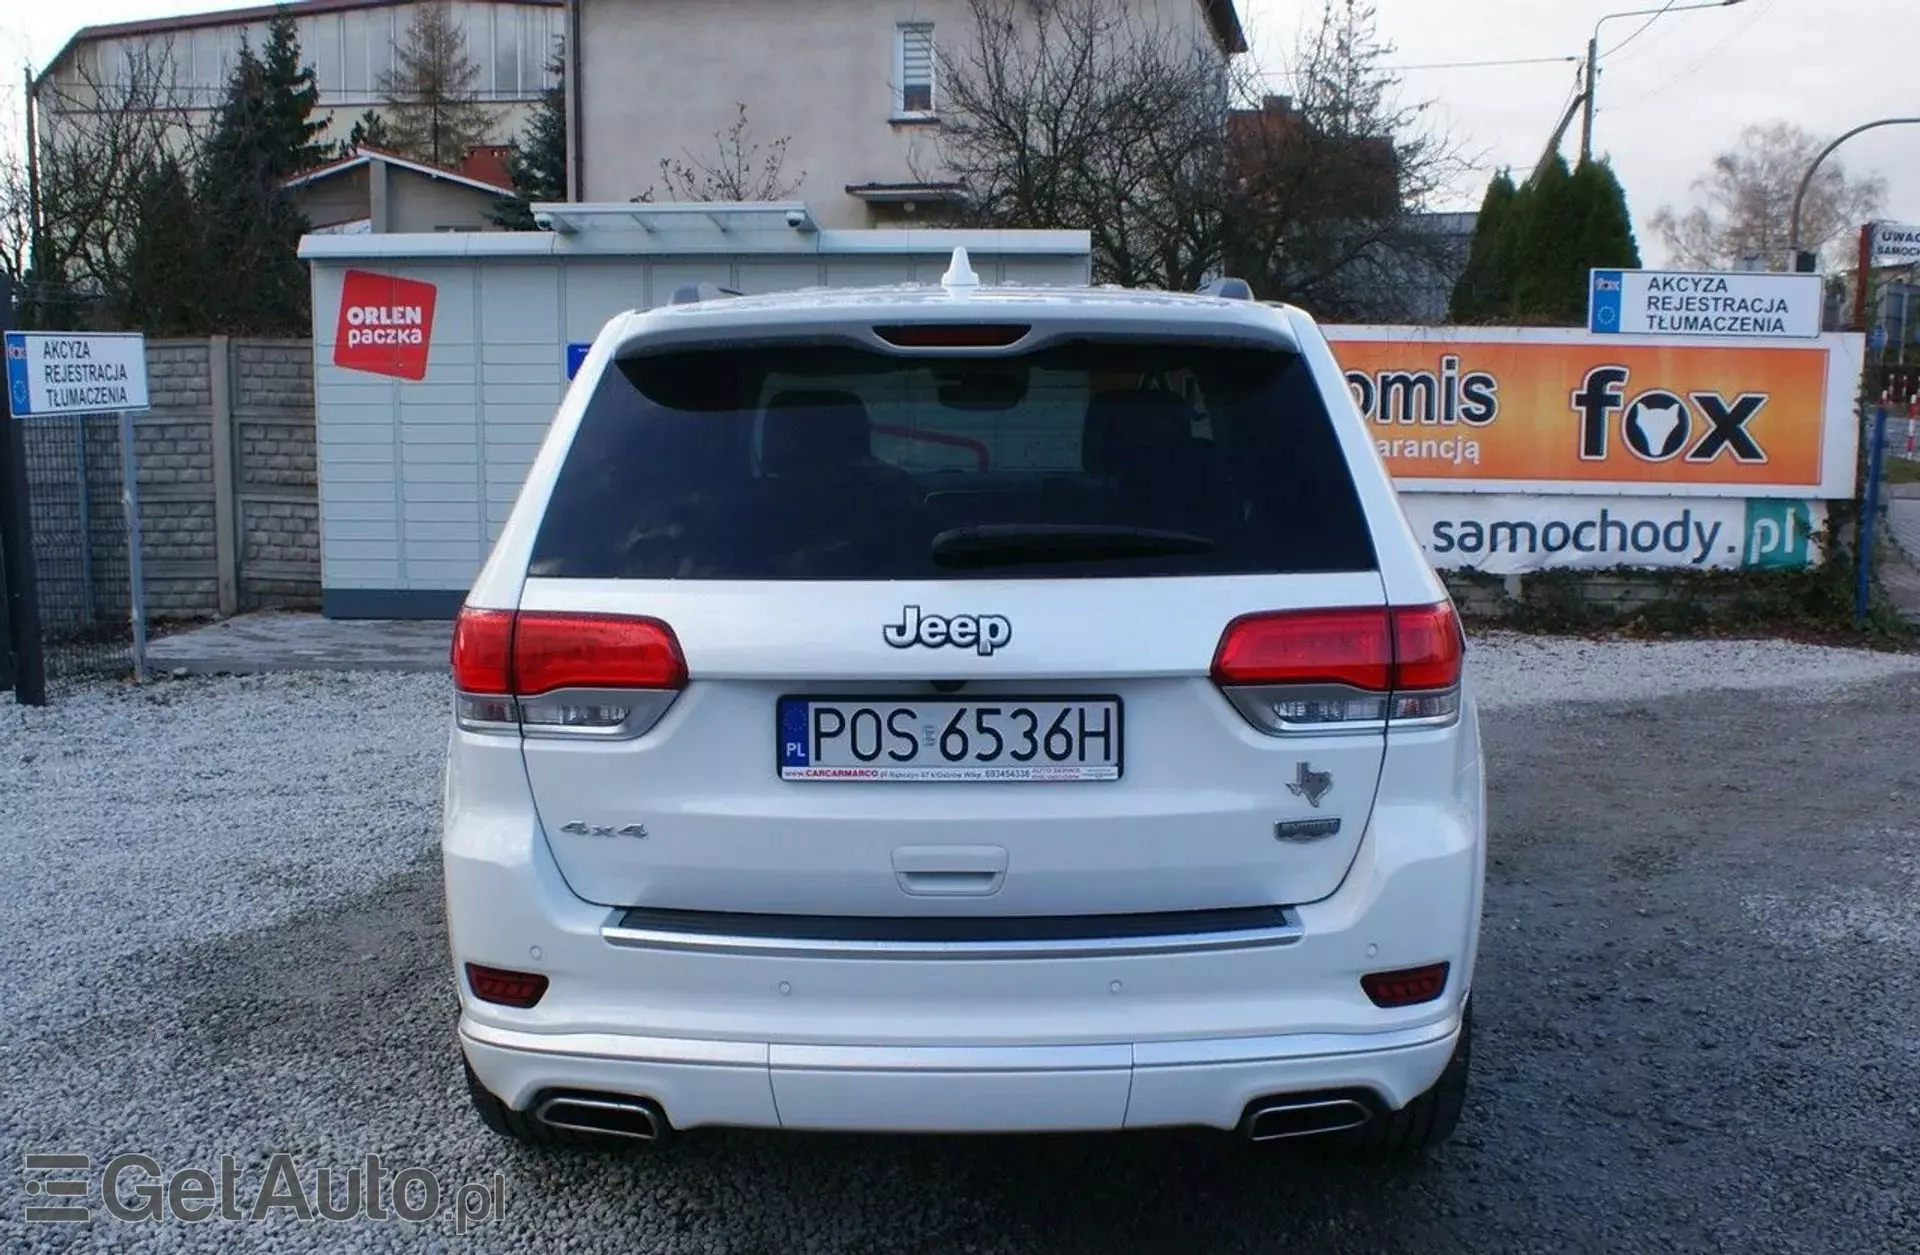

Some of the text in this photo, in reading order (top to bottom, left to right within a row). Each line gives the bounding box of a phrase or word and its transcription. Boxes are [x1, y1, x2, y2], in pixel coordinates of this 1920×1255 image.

[1648, 276, 1728, 293] AKCYZA
[1646, 296, 1789, 313] REJESTRACJA
[346, 305, 422, 325] ORLEN
[1646, 314, 1786, 333] TŁUMACZENIA
[347, 327, 423, 350] paczka
[43, 340, 92, 359] AKCYZA
[44, 363, 129, 383] REJESTRACJA
[46, 386, 129, 408] TŁUMACZENIA
[1344, 354, 1769, 463] omis fox
[1376, 436, 1480, 464] arancją
[883, 604, 1012, 656] Jeep
[814, 707, 1111, 762] POS 6536H
[786, 741, 806, 758] PL
[560, 820, 648, 840] 4x4
